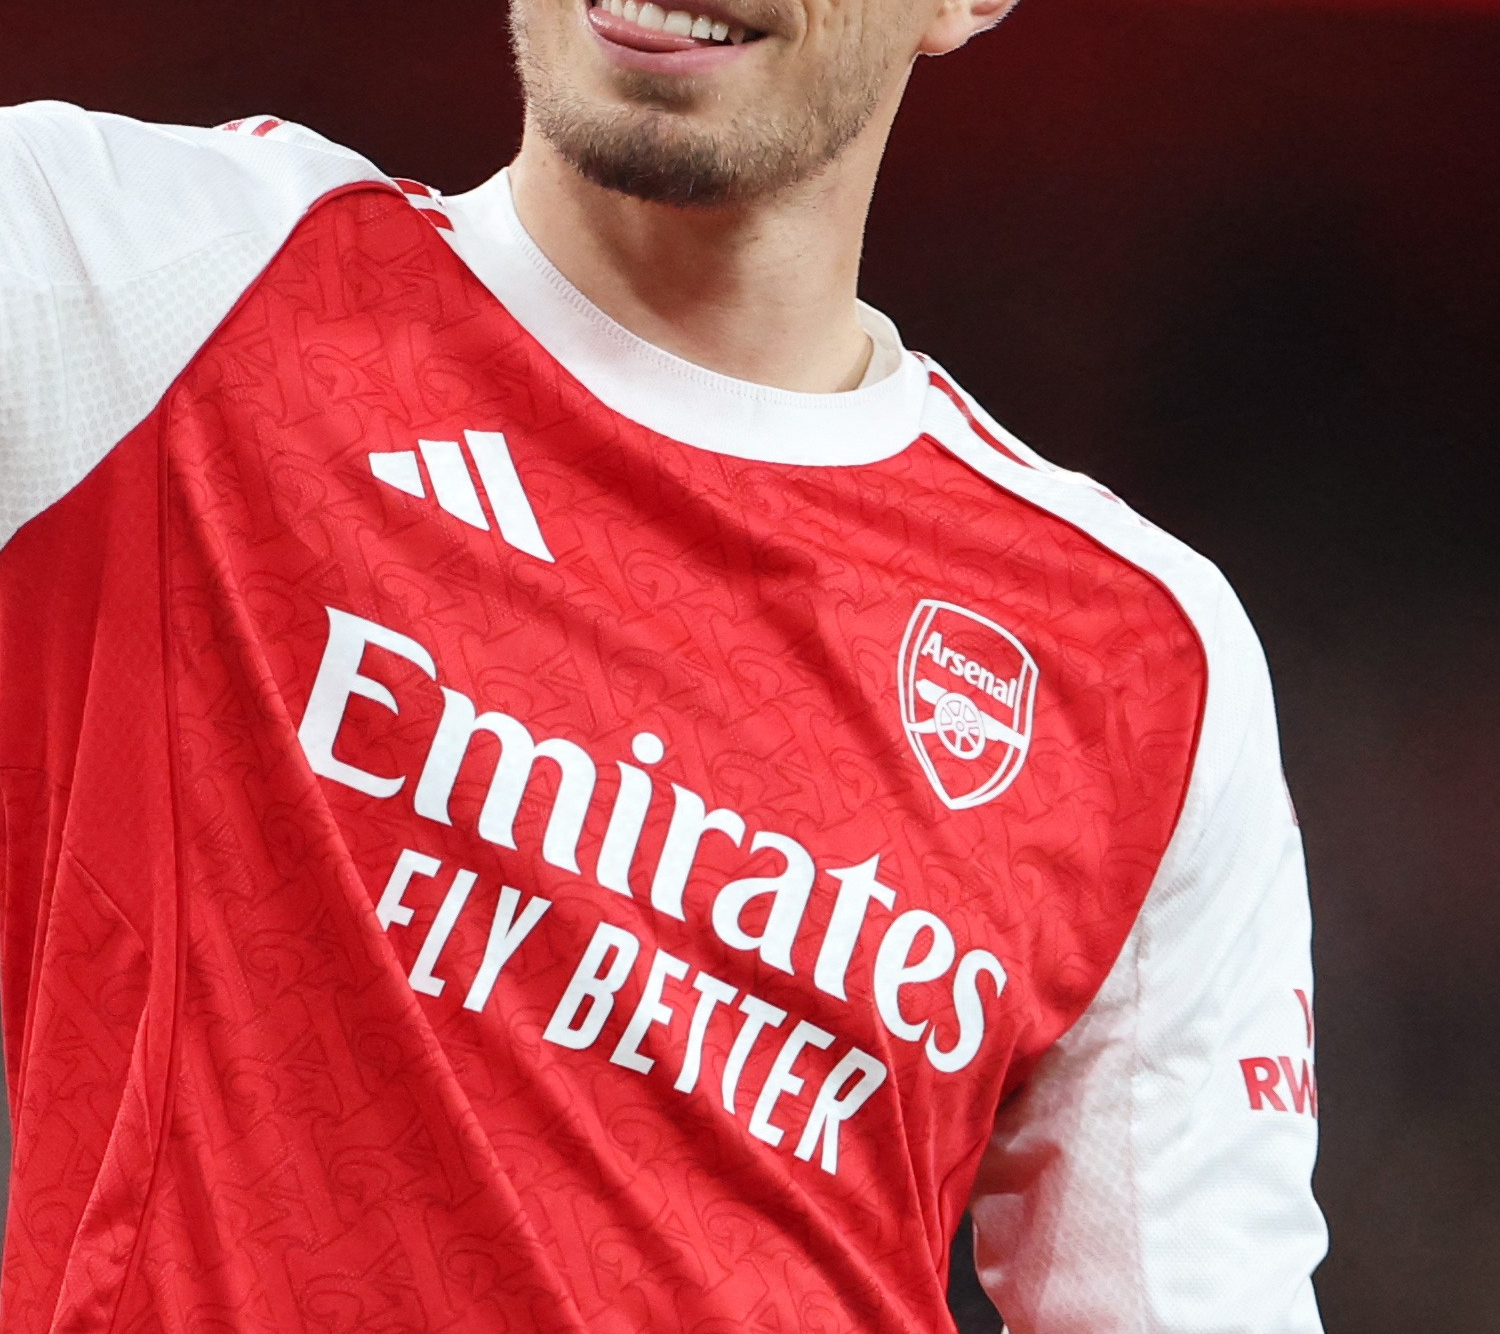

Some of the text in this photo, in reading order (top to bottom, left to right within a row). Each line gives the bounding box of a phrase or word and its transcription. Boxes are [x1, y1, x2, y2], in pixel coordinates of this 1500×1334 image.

[920, 630, 1018, 709] Arsenal
[297, 605, 1008, 1073] Emirates
[375, 848, 887, 1176] FLY BETTER
